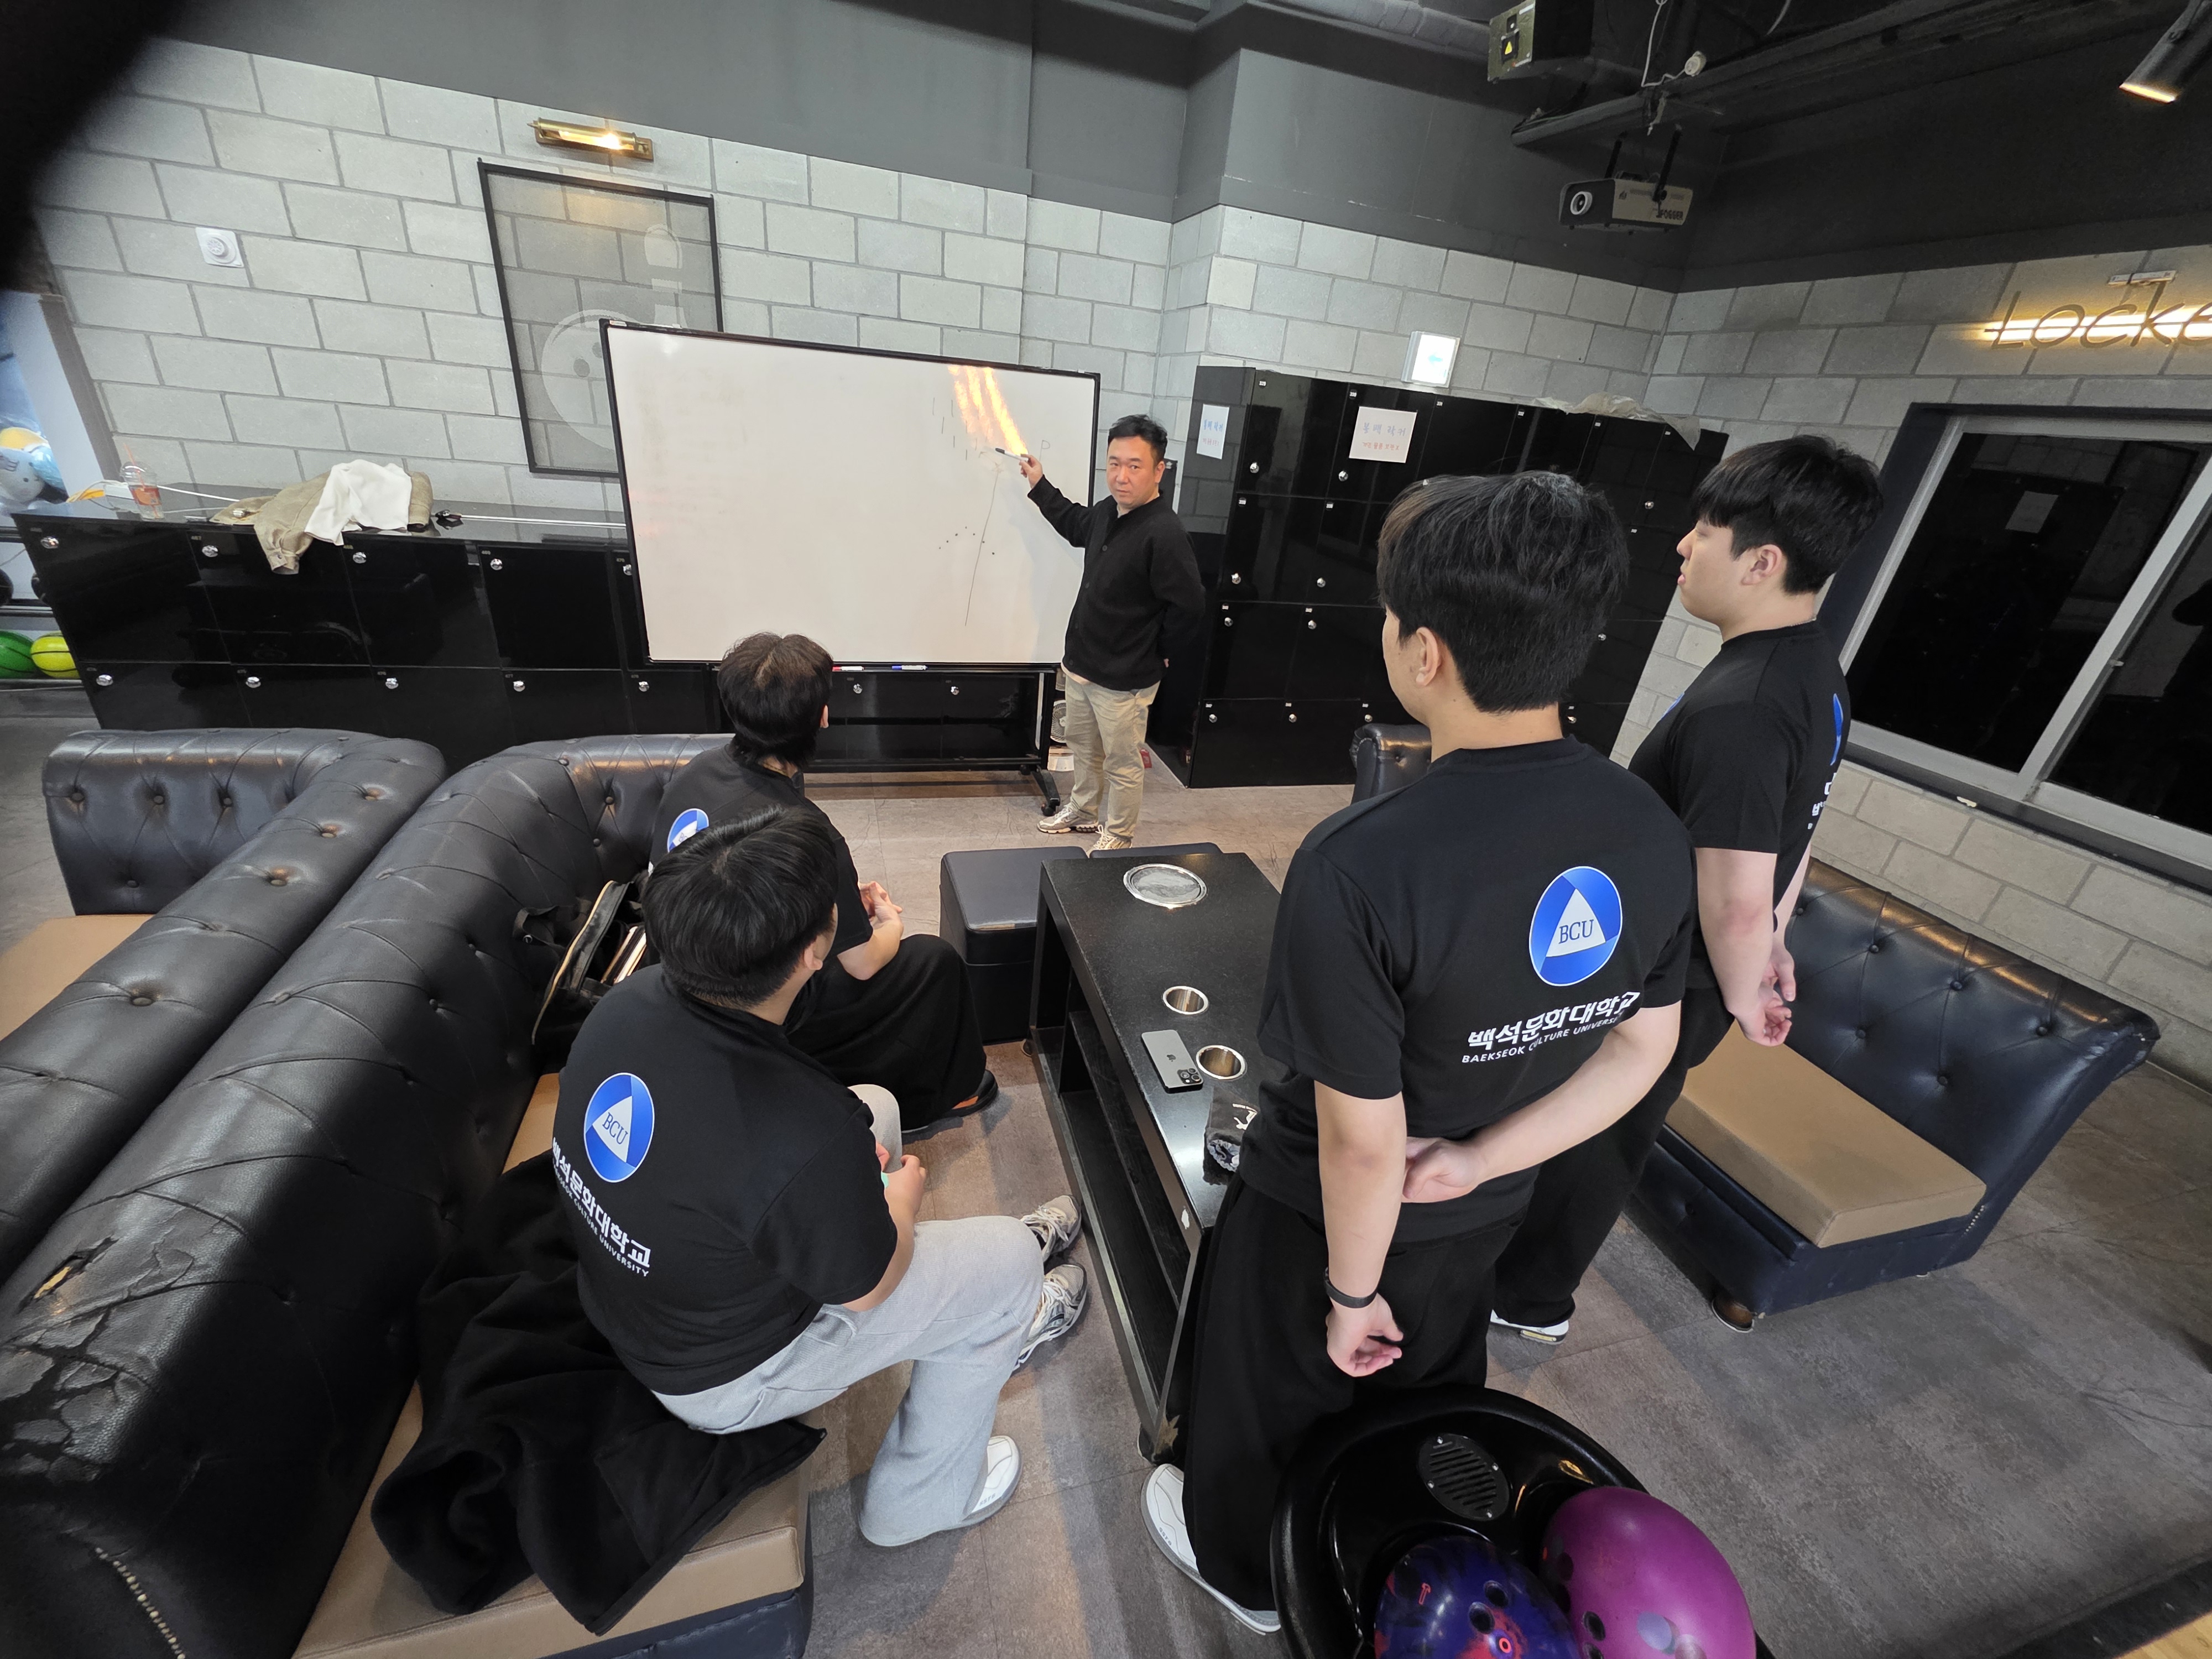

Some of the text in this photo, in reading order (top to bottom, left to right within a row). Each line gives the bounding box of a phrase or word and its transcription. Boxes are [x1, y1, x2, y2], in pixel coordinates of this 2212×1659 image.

[1558, 919, 1594, 945] BCU
[1467, 991, 1641, 1051] 백석문화대학교
[1462, 1045, 1525, 1063] BAEKSEOK
[1528, 1029, 1570, 1052] CULTURE
[602, 1112, 629, 1146] BCU
[552, 1137, 651, 1269] 백석문화대학교
[573, 1198, 598, 1236] CULTURE
[599, 1234, 650, 1277] UNIVERSITY
